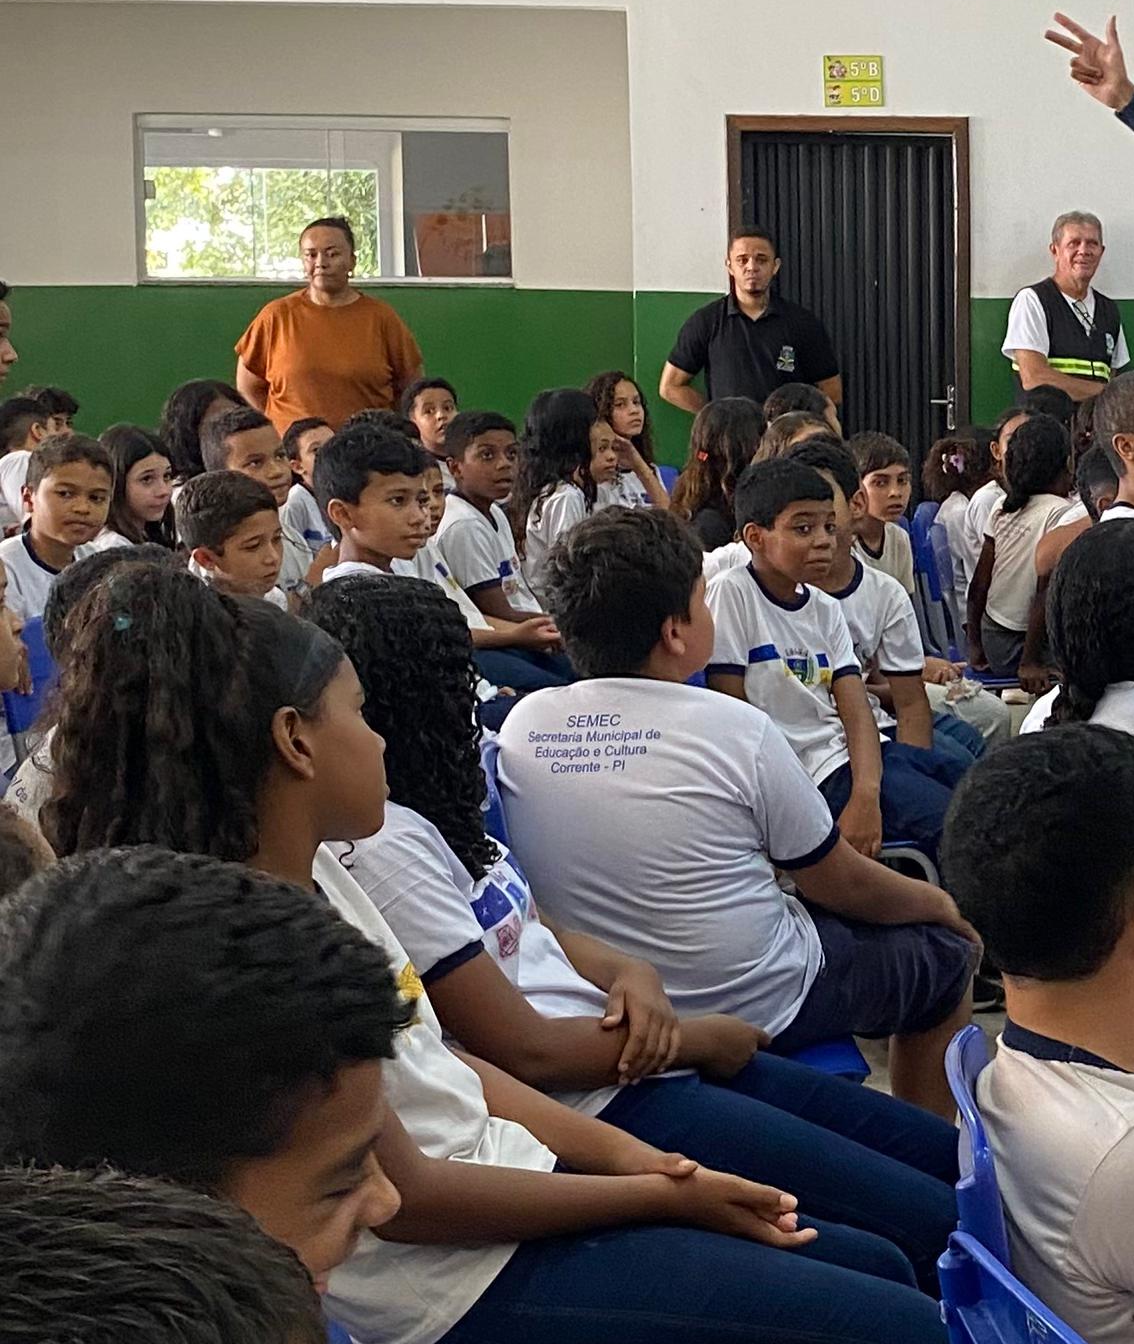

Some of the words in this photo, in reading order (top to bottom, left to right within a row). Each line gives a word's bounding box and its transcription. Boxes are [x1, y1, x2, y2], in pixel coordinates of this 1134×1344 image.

[566, 714, 621, 728] SEMEC
[528, 731, 582, 743] Secretaria
[586, 729, 642, 743] Municipal
[645, 729, 661, 740] de
[535, 746, 590, 761] Educação
[593, 748, 601, 757] e
[604, 744, 647, 757] Cultura
[551, 760, 600, 774] Corrente
[612, 759, 626, 772] PI
